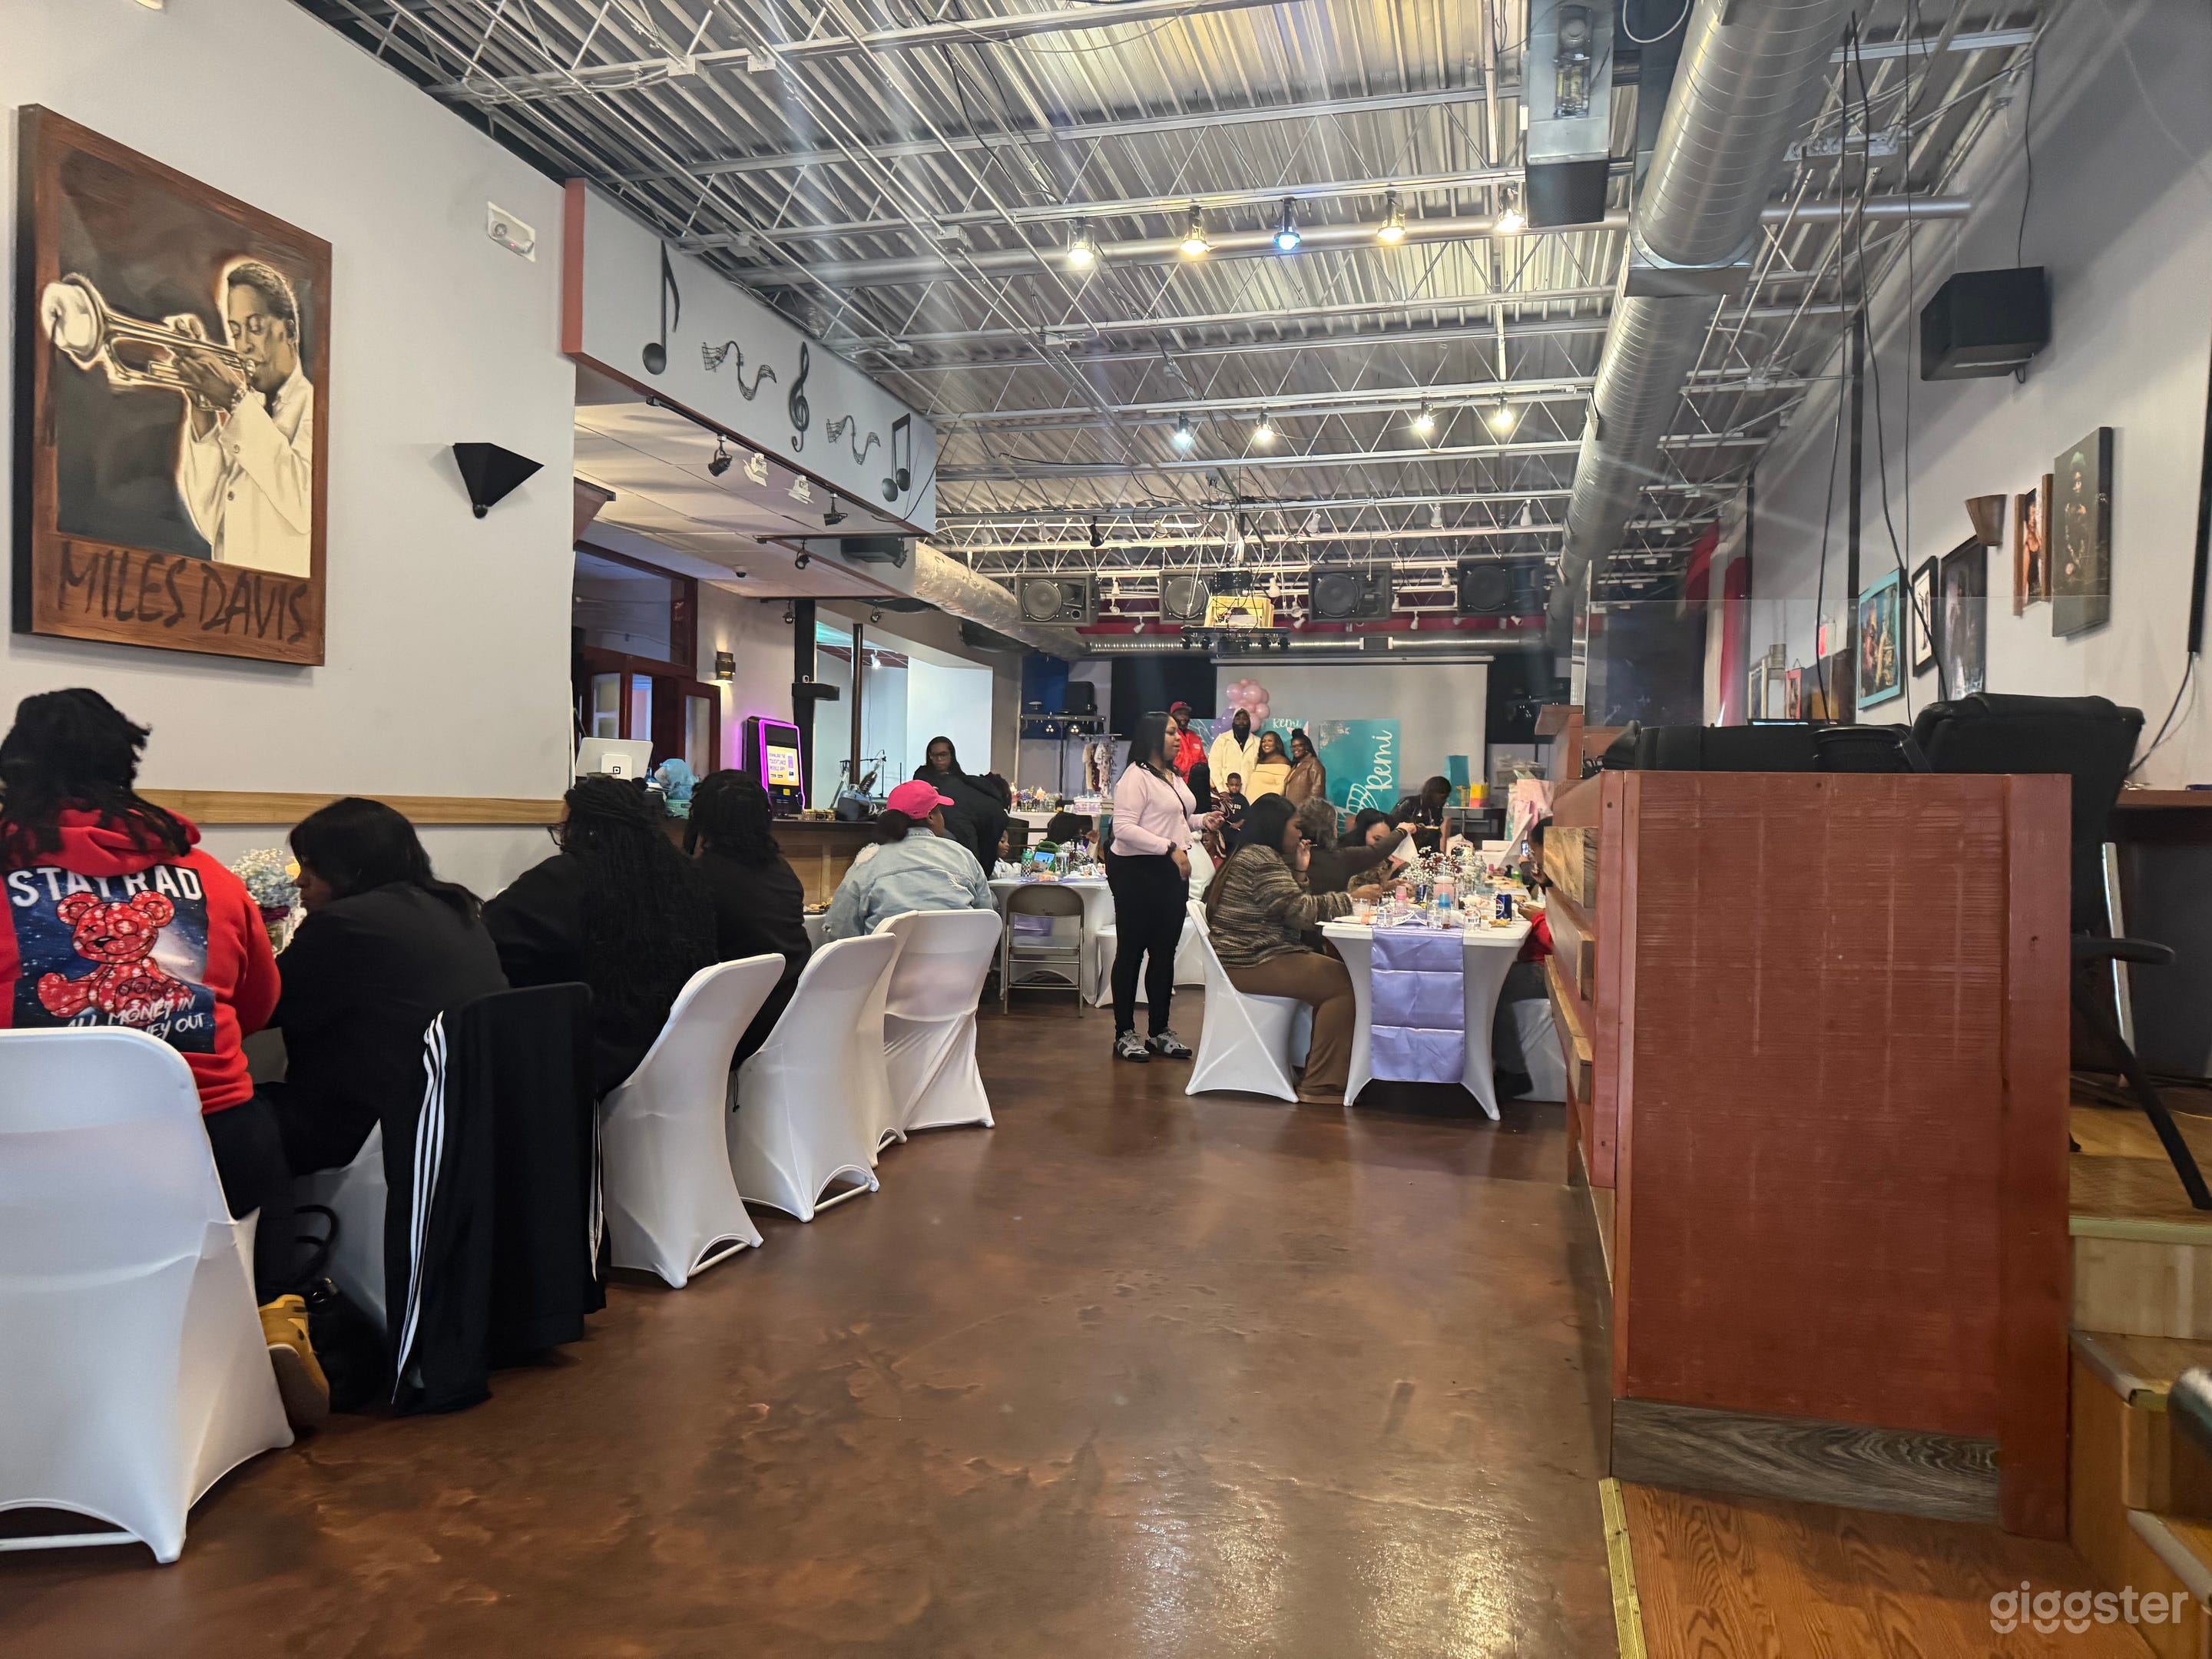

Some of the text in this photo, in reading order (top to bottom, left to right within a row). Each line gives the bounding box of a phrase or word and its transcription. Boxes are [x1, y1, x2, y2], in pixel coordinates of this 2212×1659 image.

[58, 539, 308, 644] MILES DAVIS
[1365, 729, 1393, 792] Remi
[8, 865, 203, 908] STAY RAD
[108, 996, 174, 1025] MONEY
[177, 994, 196, 1012] IN
[175, 1012, 205, 1033] OUT
